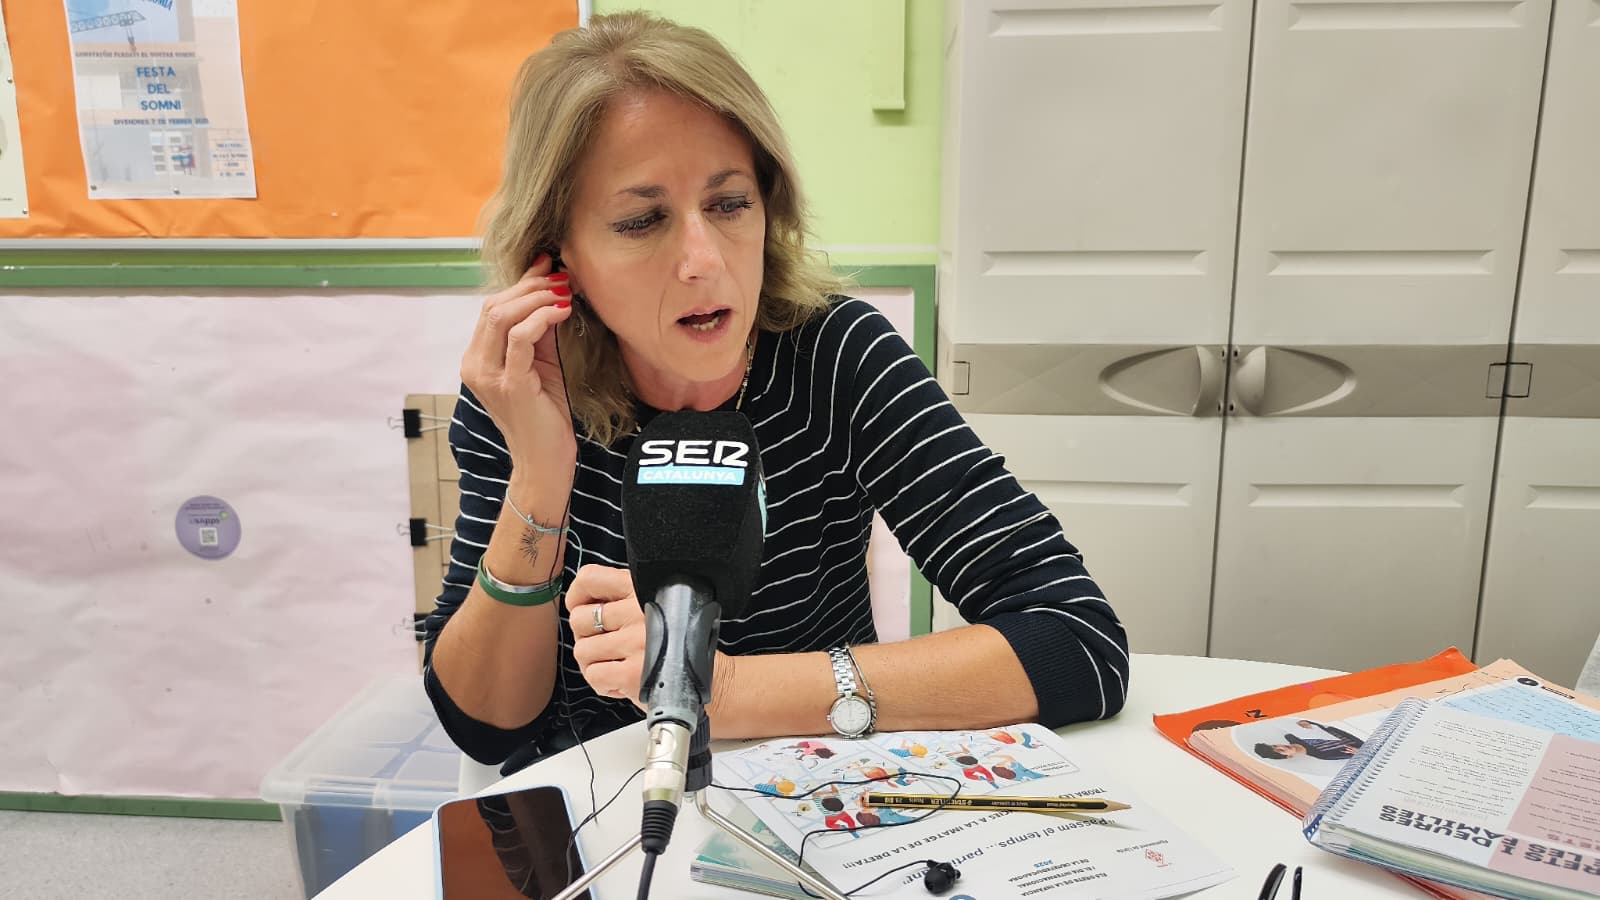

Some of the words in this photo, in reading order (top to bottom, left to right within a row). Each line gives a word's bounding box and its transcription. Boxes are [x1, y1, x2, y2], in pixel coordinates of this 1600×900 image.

[136, 66, 176, 78] FESTA
[147, 83, 171, 95] DEL
[140, 100, 182, 111] SOMNI
[638, 440, 750, 468] SER
[643, 469, 737, 482] CATALUNYA
[1075, 787, 1108, 798] TROBA
[964, 819, 979, 828] LA
[1380, 804, 1519, 847] FAMILIES
[923, 825, 964, 843] IMATGE
[1043, 827, 1055, 837] el
[1379, 812, 1493, 849] DEURES
[892, 846, 907, 855] LA
[907, 840, 922, 849] DE
[1501, 844, 1516, 856] I
[1528, 843, 1583, 863] LES
[1523, 851, 1600, 877] RETS
[1017, 871, 1073, 889] INTERNACIONAL
